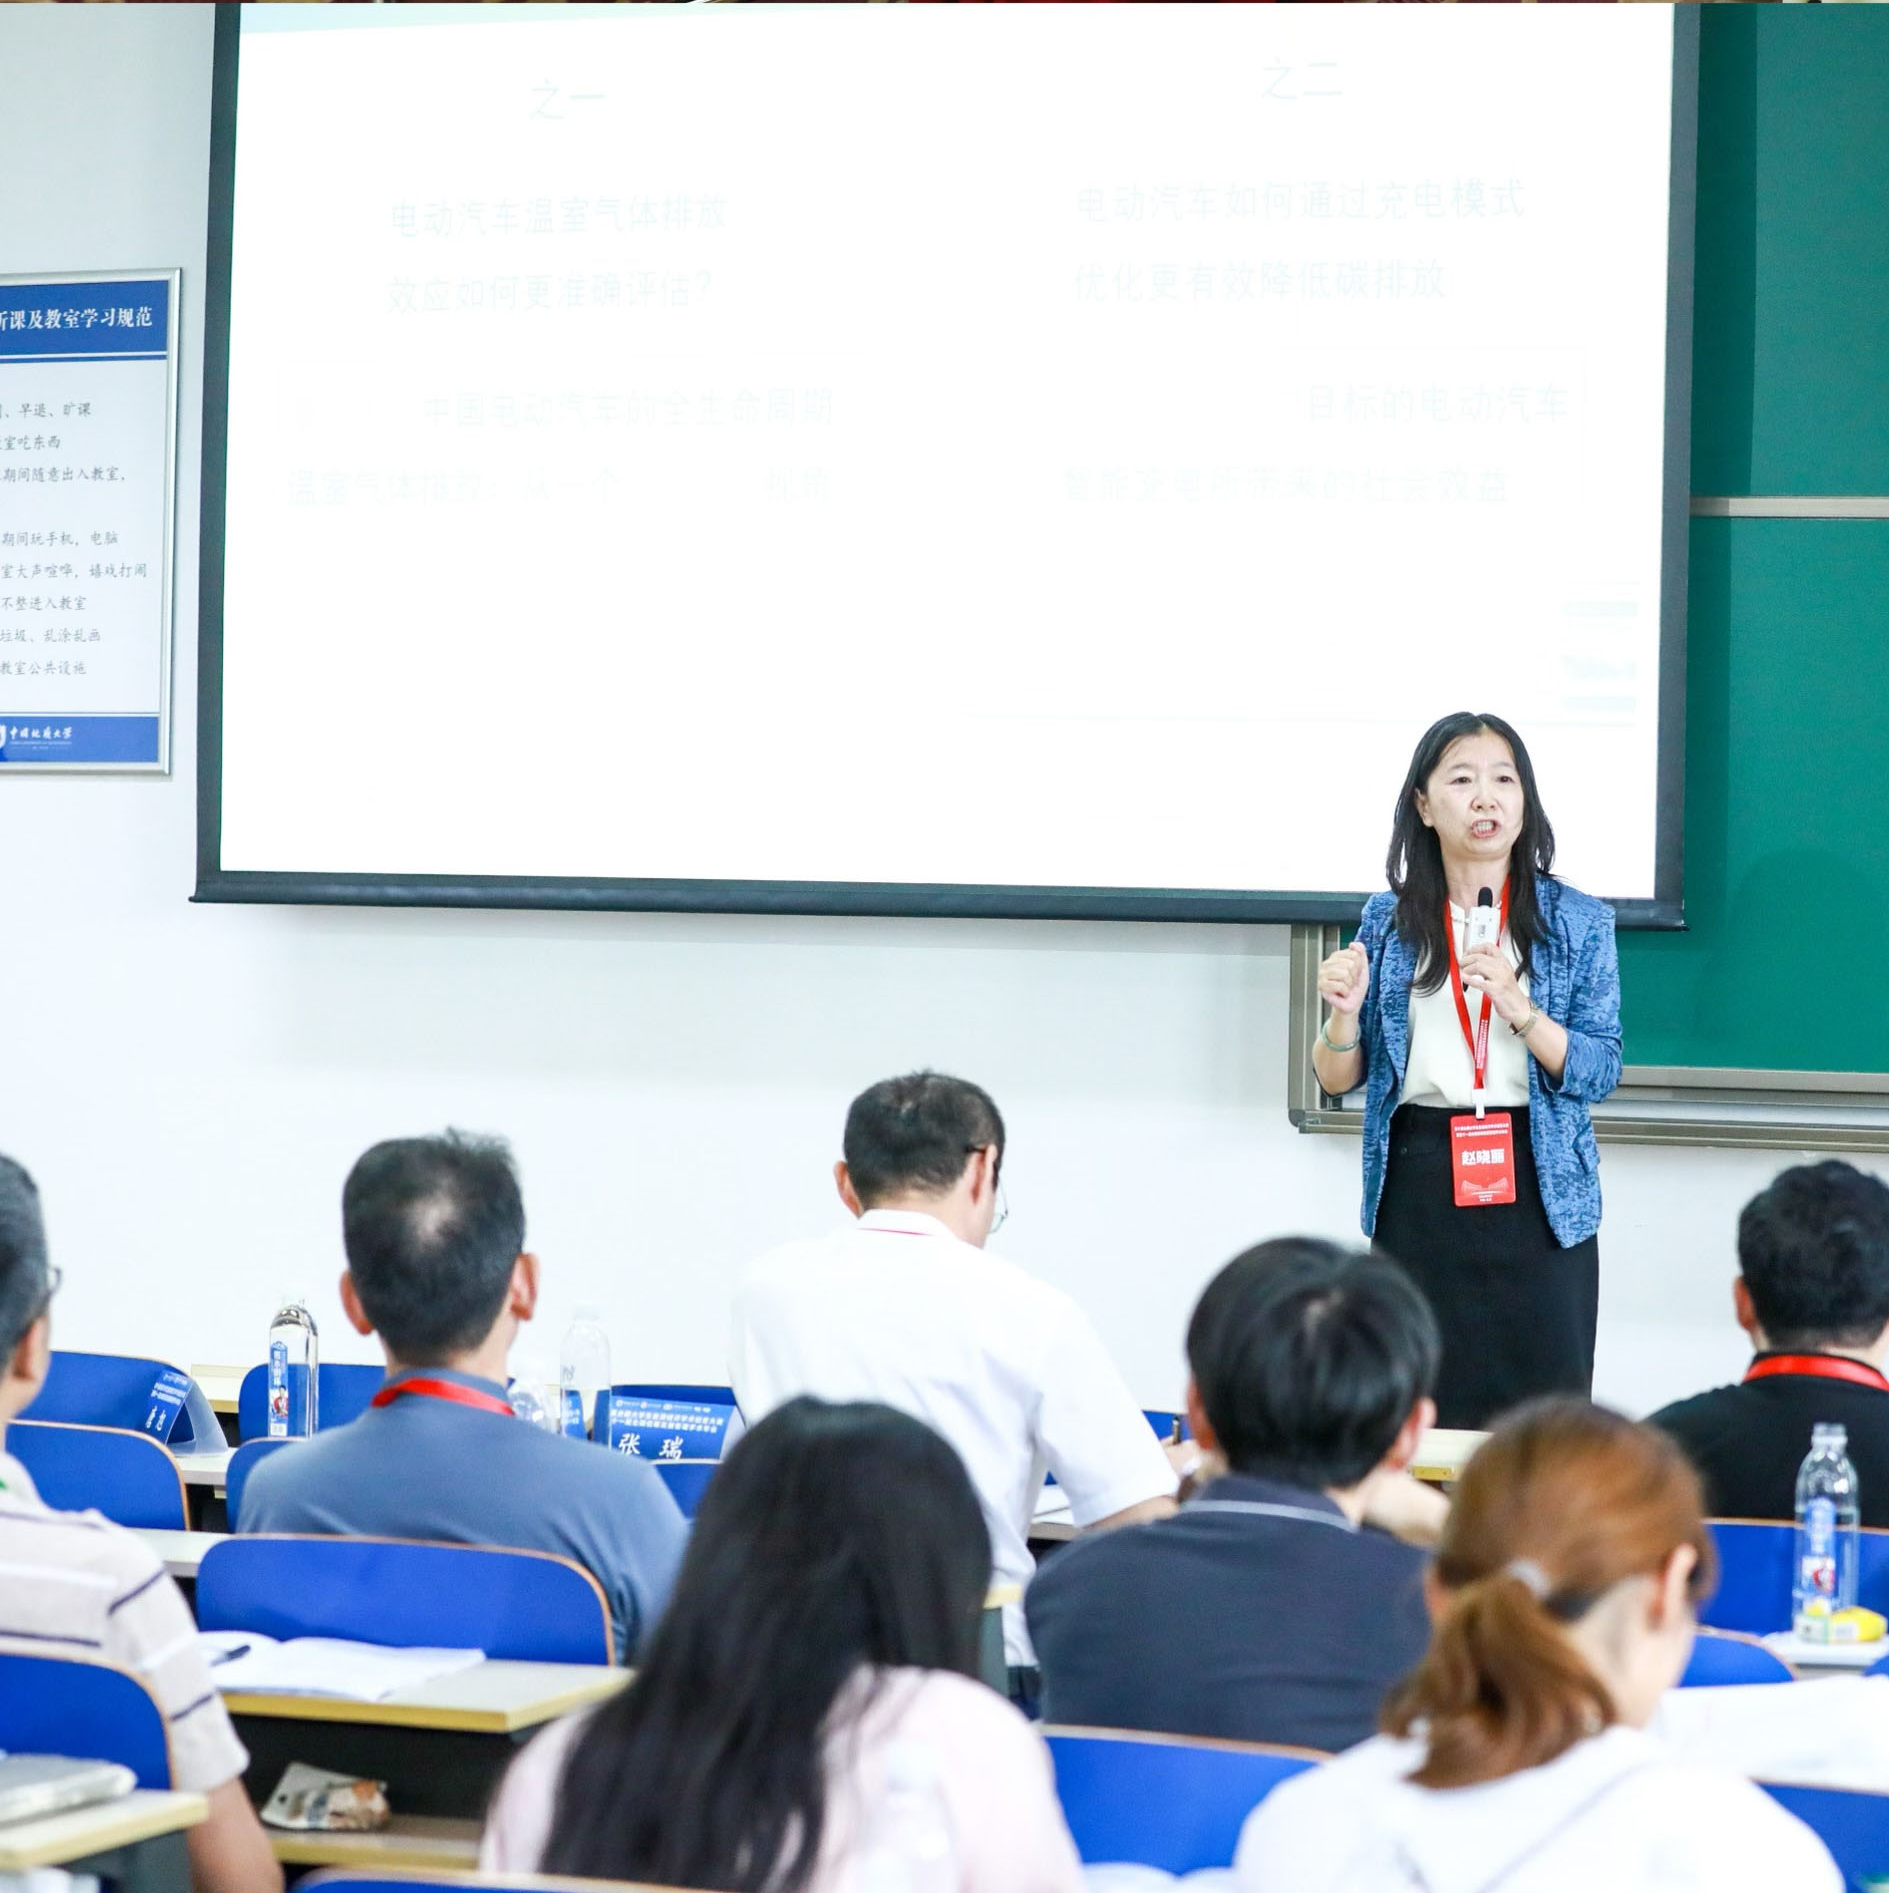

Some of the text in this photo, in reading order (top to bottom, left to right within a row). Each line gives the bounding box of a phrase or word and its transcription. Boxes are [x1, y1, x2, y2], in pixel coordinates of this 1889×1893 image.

[0, 402, 91, 419] 、早退、旷课
[0, 435, 61, 451] 室吃东西
